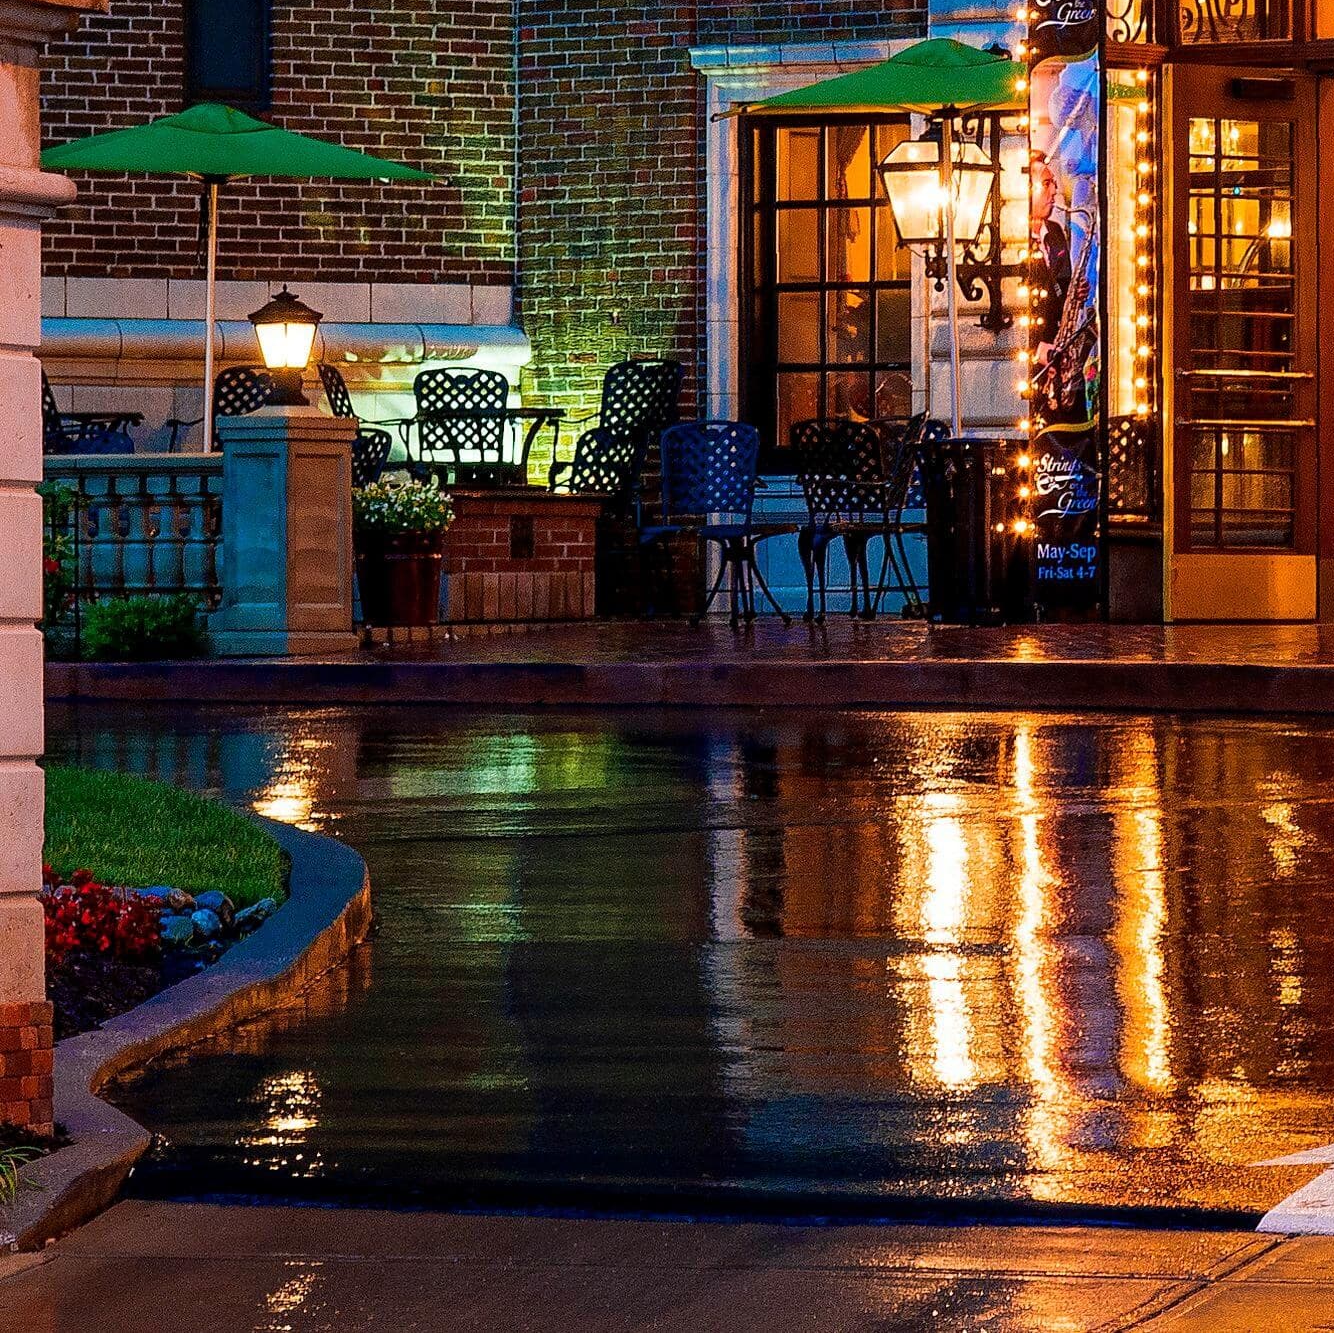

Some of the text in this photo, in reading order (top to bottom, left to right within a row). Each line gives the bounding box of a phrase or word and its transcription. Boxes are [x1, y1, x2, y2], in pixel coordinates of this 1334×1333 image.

[1057, 3, 1097, 29] Green
[1037, 453, 1081, 476] Strings
[1058, 491, 1096, 519] Green
[1037, 544, 1096, 563] May-Sep
[1038, 566, 1096, 579] Fri-Sat 4-7
